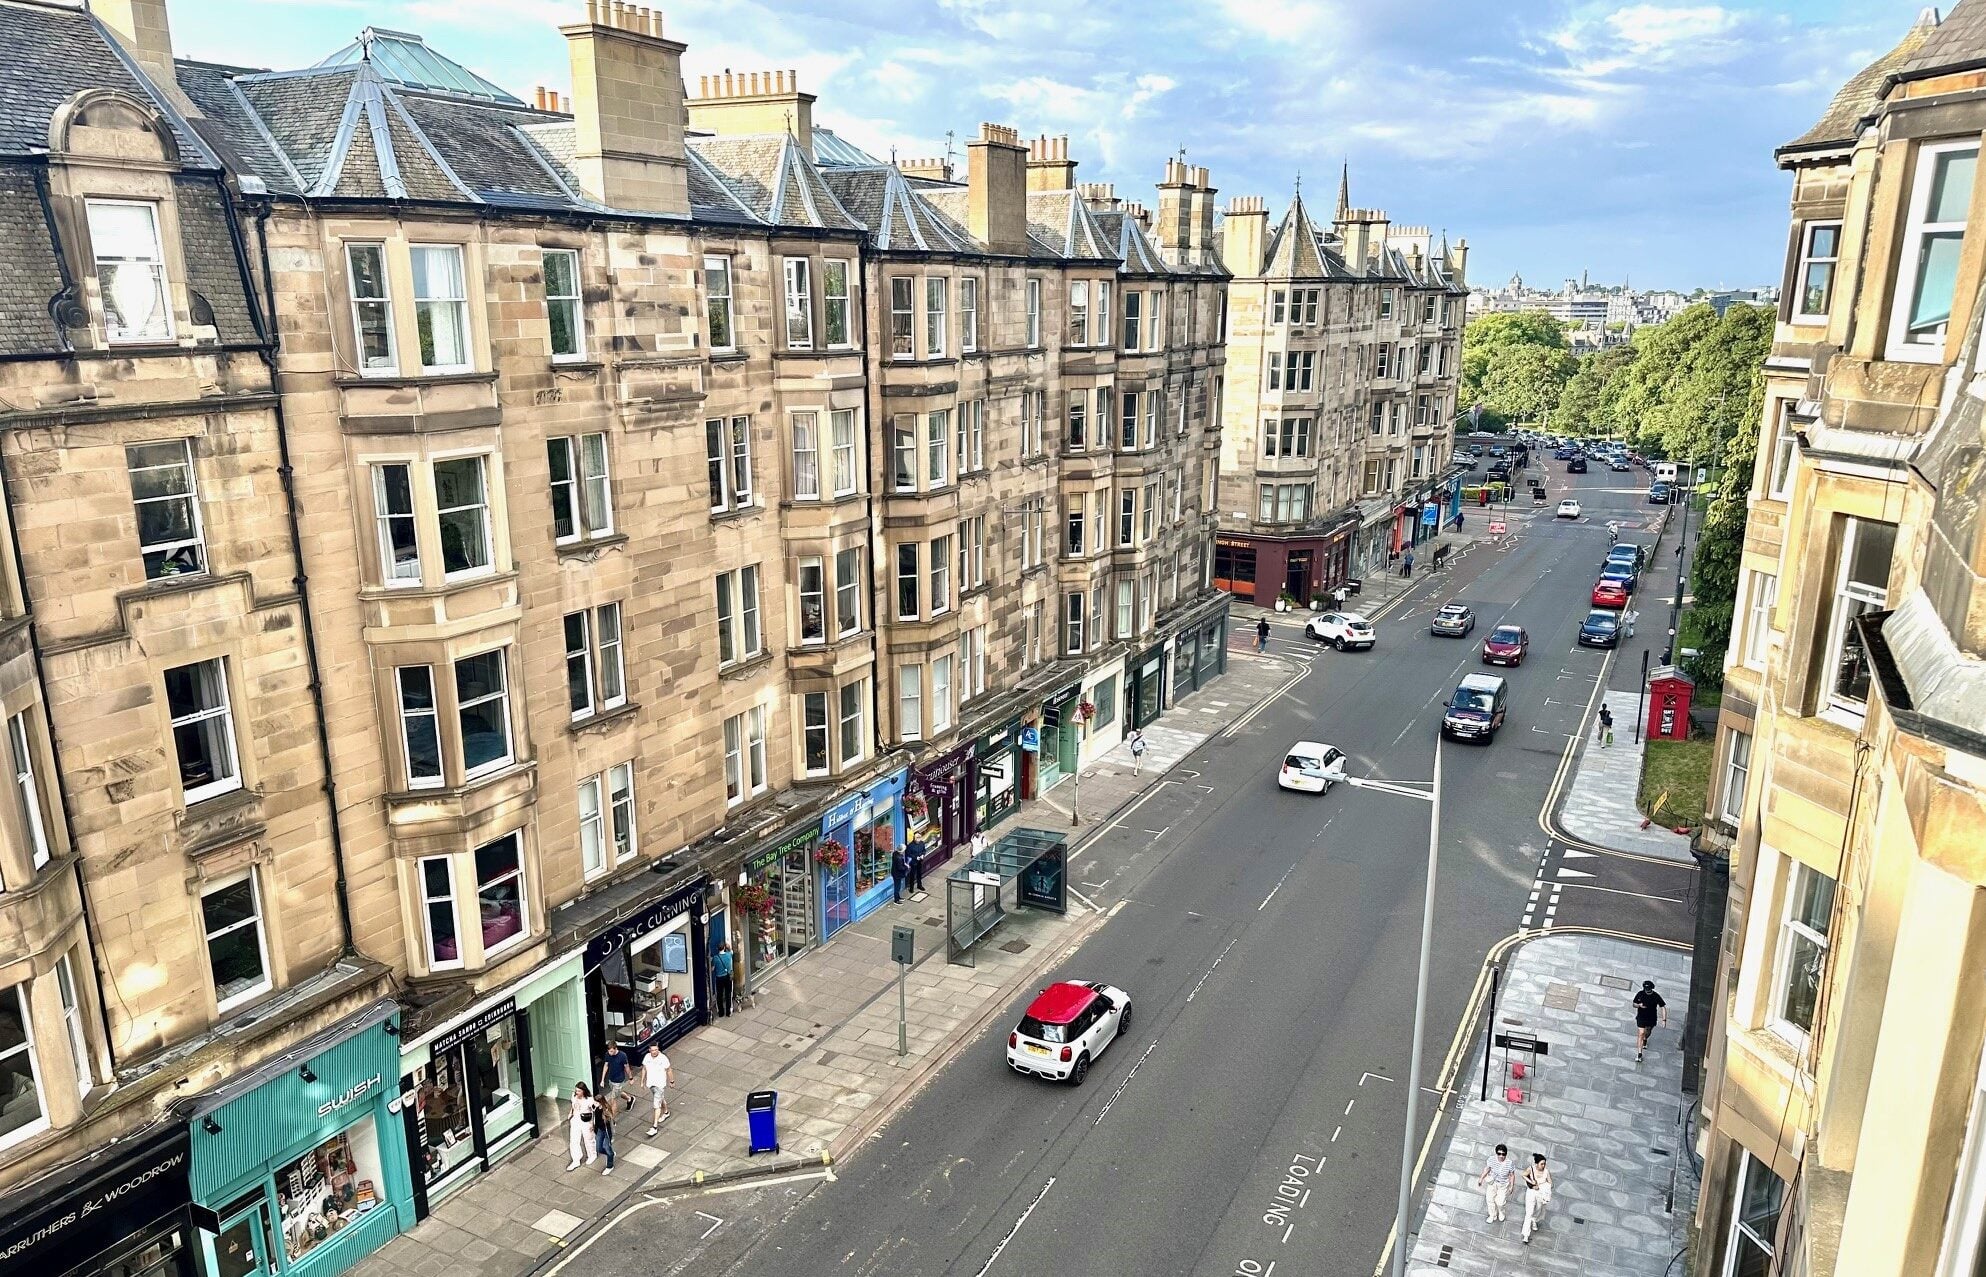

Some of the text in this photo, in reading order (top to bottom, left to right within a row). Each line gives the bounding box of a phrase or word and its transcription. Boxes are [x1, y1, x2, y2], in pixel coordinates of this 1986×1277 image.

[1231, 540, 1250, 548] STREET
[753, 827, 820, 870] The Bay Tree Company
[647, 892, 697, 928] CUNNING
[317, 1072, 382, 1118] SWISH
[0, 1212, 76, 1260] ARRUTHERS
[105, 1152, 184, 1203] WOODROW
[1262, 1153, 1316, 1227] LOADING
